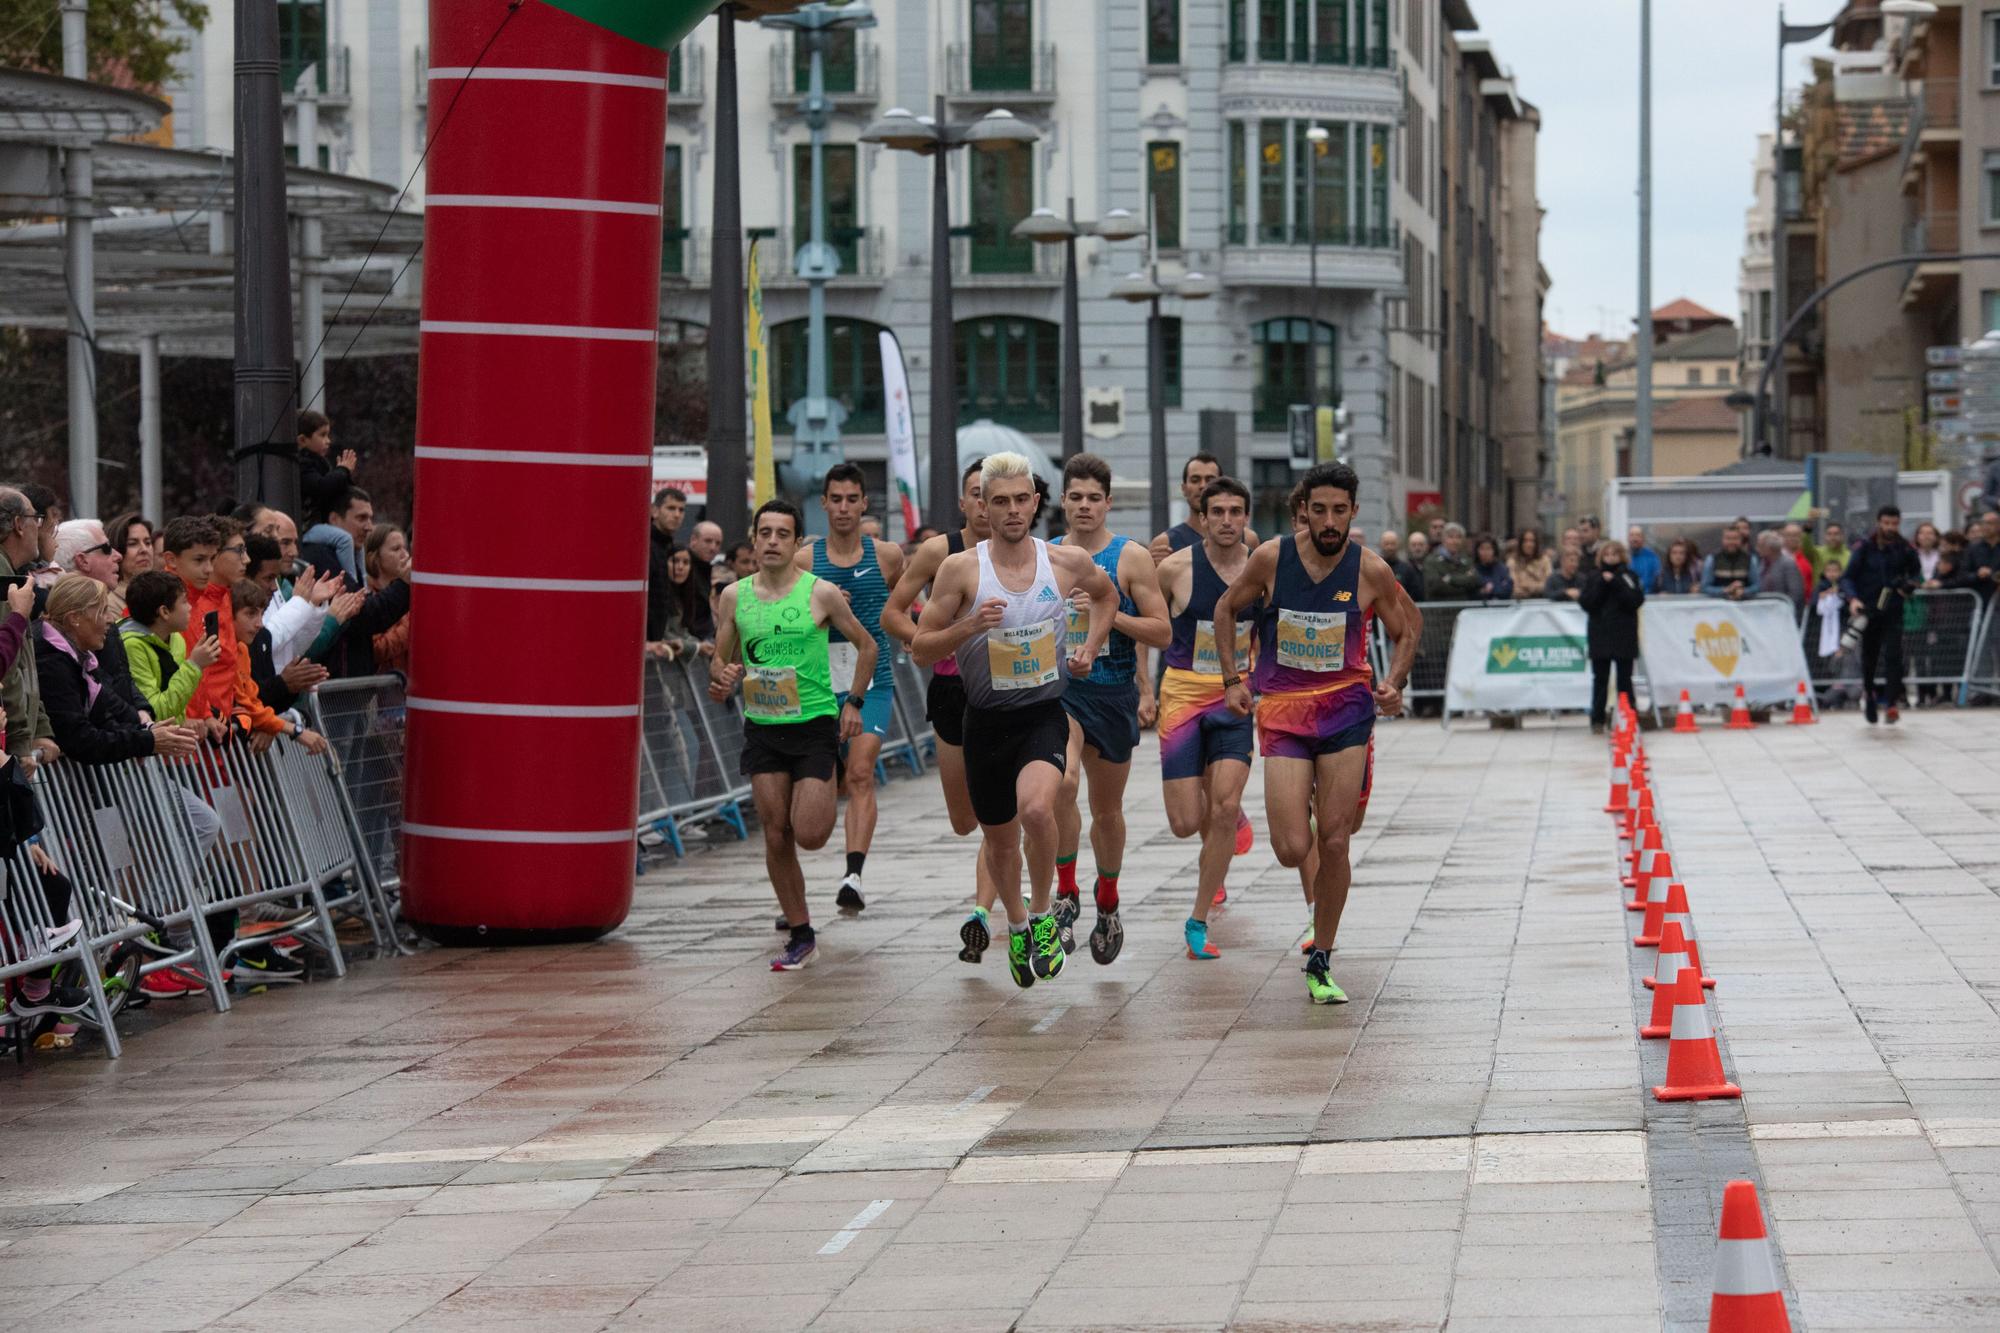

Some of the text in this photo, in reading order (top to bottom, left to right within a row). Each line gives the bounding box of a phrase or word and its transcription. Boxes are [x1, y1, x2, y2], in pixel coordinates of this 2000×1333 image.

[1069, 613, 1079, 626] 7
[1305, 627, 1316, 640] 6
[764, 648, 806, 656] MENORCA
[1020, 641, 1031, 656] 3
[1012, 658, 1040, 675] BEN
[760, 680, 777, 691] 12
